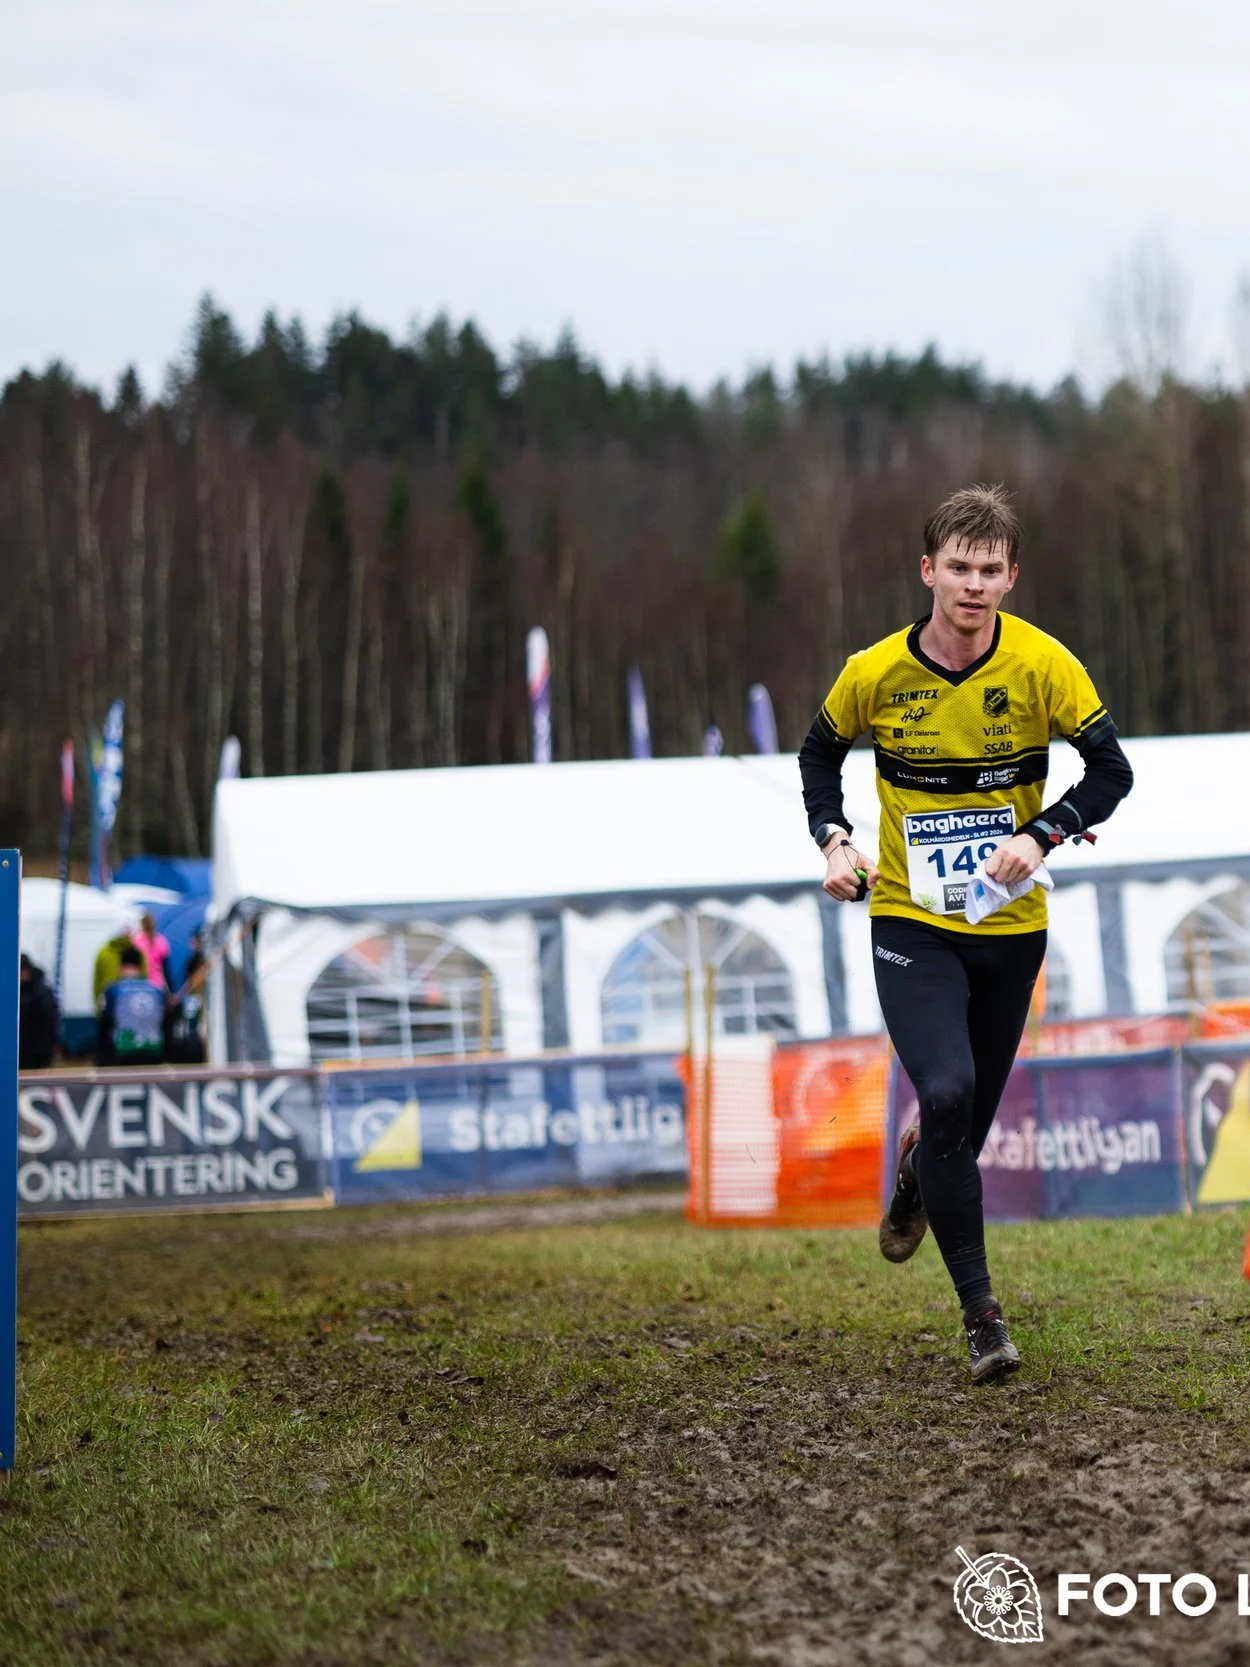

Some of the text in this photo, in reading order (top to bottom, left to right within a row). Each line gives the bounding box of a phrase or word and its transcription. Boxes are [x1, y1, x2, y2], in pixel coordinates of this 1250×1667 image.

[892, 689, 939, 704] TRIMTEX
[983, 723, 1012, 737] viati
[898, 745, 936, 756] granitor
[984, 741, 1013, 755] SSAB
[897, 771, 948, 784] LUMONITE
[907, 812, 1012, 834] bagheera
[875, 945, 913, 967] TRIMTEX
[18, 1078, 295, 1152] SVENSK
[18, 1149, 298, 1204] ORIENTERING
